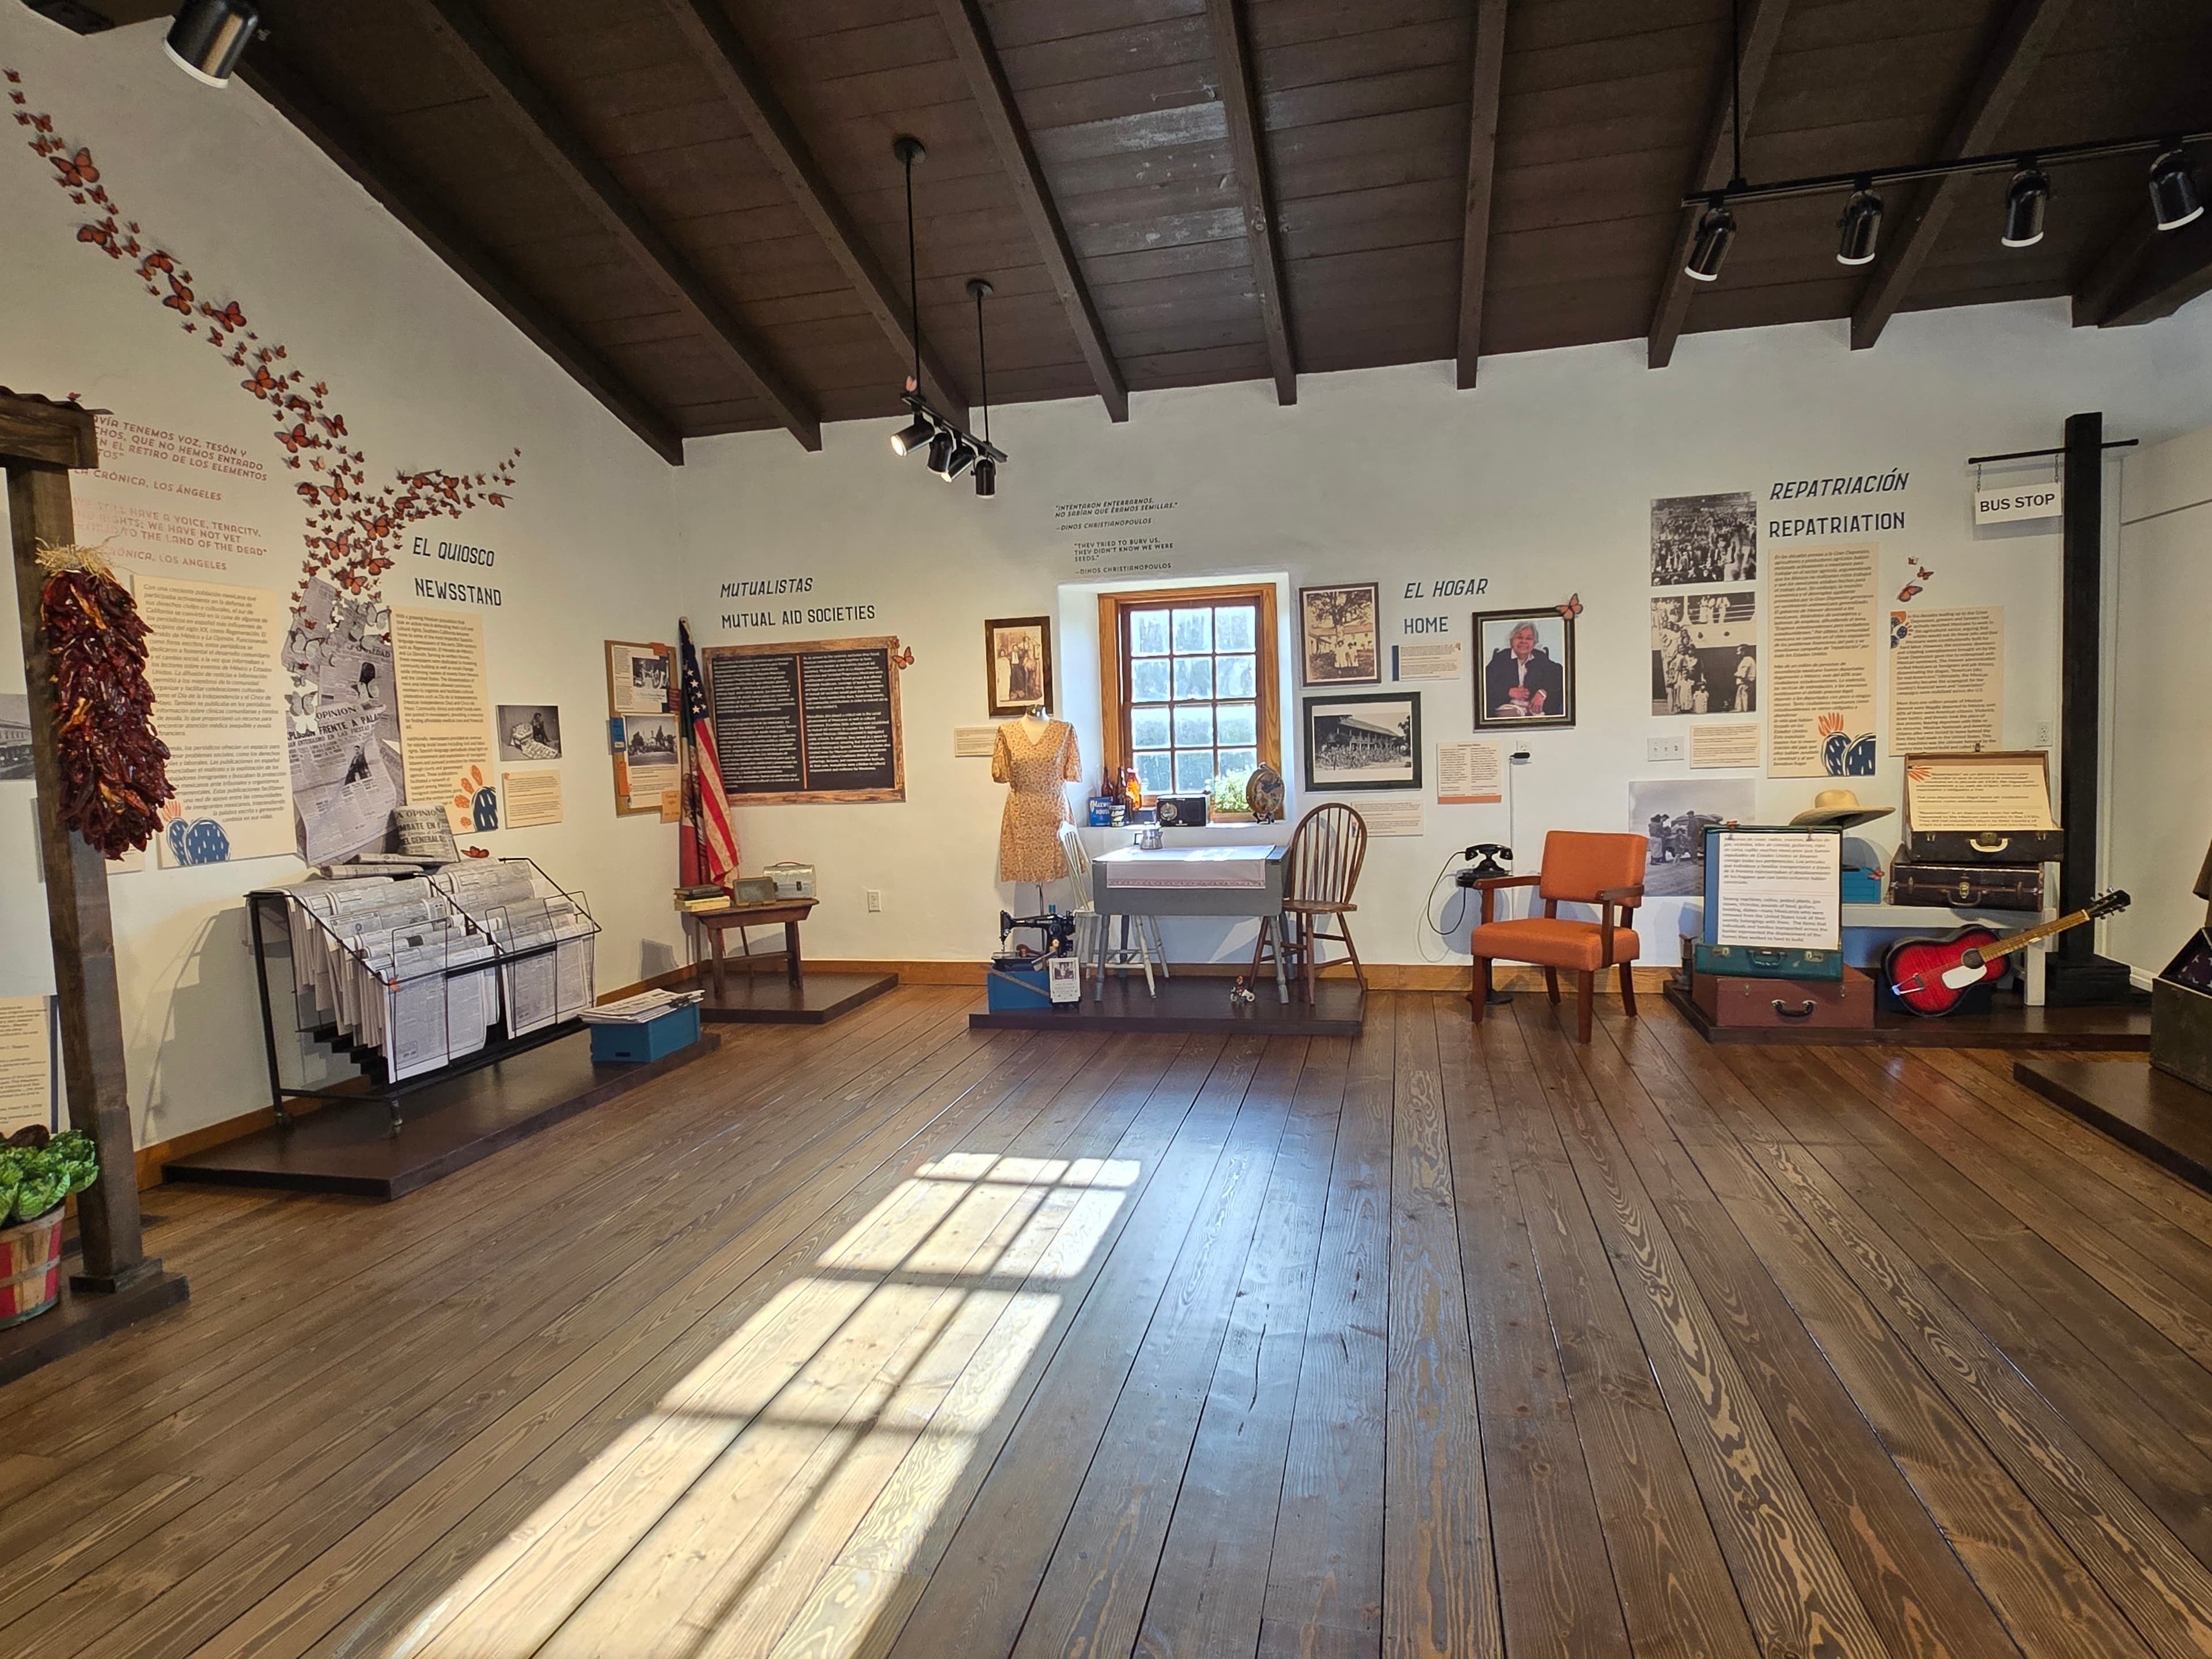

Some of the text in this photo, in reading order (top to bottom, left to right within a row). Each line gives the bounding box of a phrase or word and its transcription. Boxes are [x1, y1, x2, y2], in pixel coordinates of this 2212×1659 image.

[123, 422, 175, 441] TENEMOS
[178, 435, 202, 448] VOZ,
[206, 441, 237, 455] TESÓN
[240, 449, 247, 457] Y
[112, 441, 124, 451] EL
[129, 445, 168, 460] RETIRO
[172, 454, 187, 464] DE
[190, 458, 209, 469] LOS
[212, 463, 268, 482] ELEMENTOS
[131, 435, 155, 447] QUE
[158, 441, 175, 451] NO
[179, 445, 215, 460] HEMOS
[217, 454, 263, 471] ENTRADO
[93, 470, 149, 488] CRÓNICA,
[154, 481, 174, 492] LOS
[176, 484, 222, 501] ÁNGELES
[1770, 467, 1910, 500] REPATRIACIÓN
[1068, 508, 1092, 517] SABÍAN
[1094, 507, 1108, 516] QUE
[1111, 505, 1139, 514] ÉRAMOS
[1980, 493, 2055, 513] BUS STOP
[130, 507, 158, 520] HAVE
[174, 516, 209, 529] VOICE,
[211, 521, 262, 537] TENACITY,
[147, 521, 164, 531] WE
[168, 525, 196, 536] HAVE
[200, 529, 221, 540] NOT
[223, 533, 241, 543] YET
[1084, 518, 1152, 529] CHRISTIANOPOULOS
[1769, 512, 1906, 538] REPATRIATION
[141, 531, 162, 541] THE
[166, 534, 194, 546] LAND
[198, 539, 211, 548] OF
[214, 541, 233, 552] THE
[413, 536, 495, 567] EL QUIOSCO
[182, 558, 227, 571] ANGELES
[1103, 562, 1172, 573] CHRISTIANOPOULOS
[414, 577, 502, 607] NEWSSTAND
[720, 577, 813, 599] MUTUALISTAS
[1403, 578, 1488, 600] EL HOGAR
[721, 605, 876, 630] MUTUAL AID SOCIETIES
[1404, 616, 1449, 635] HOME
[318, 722, 348, 734] FRENTE
